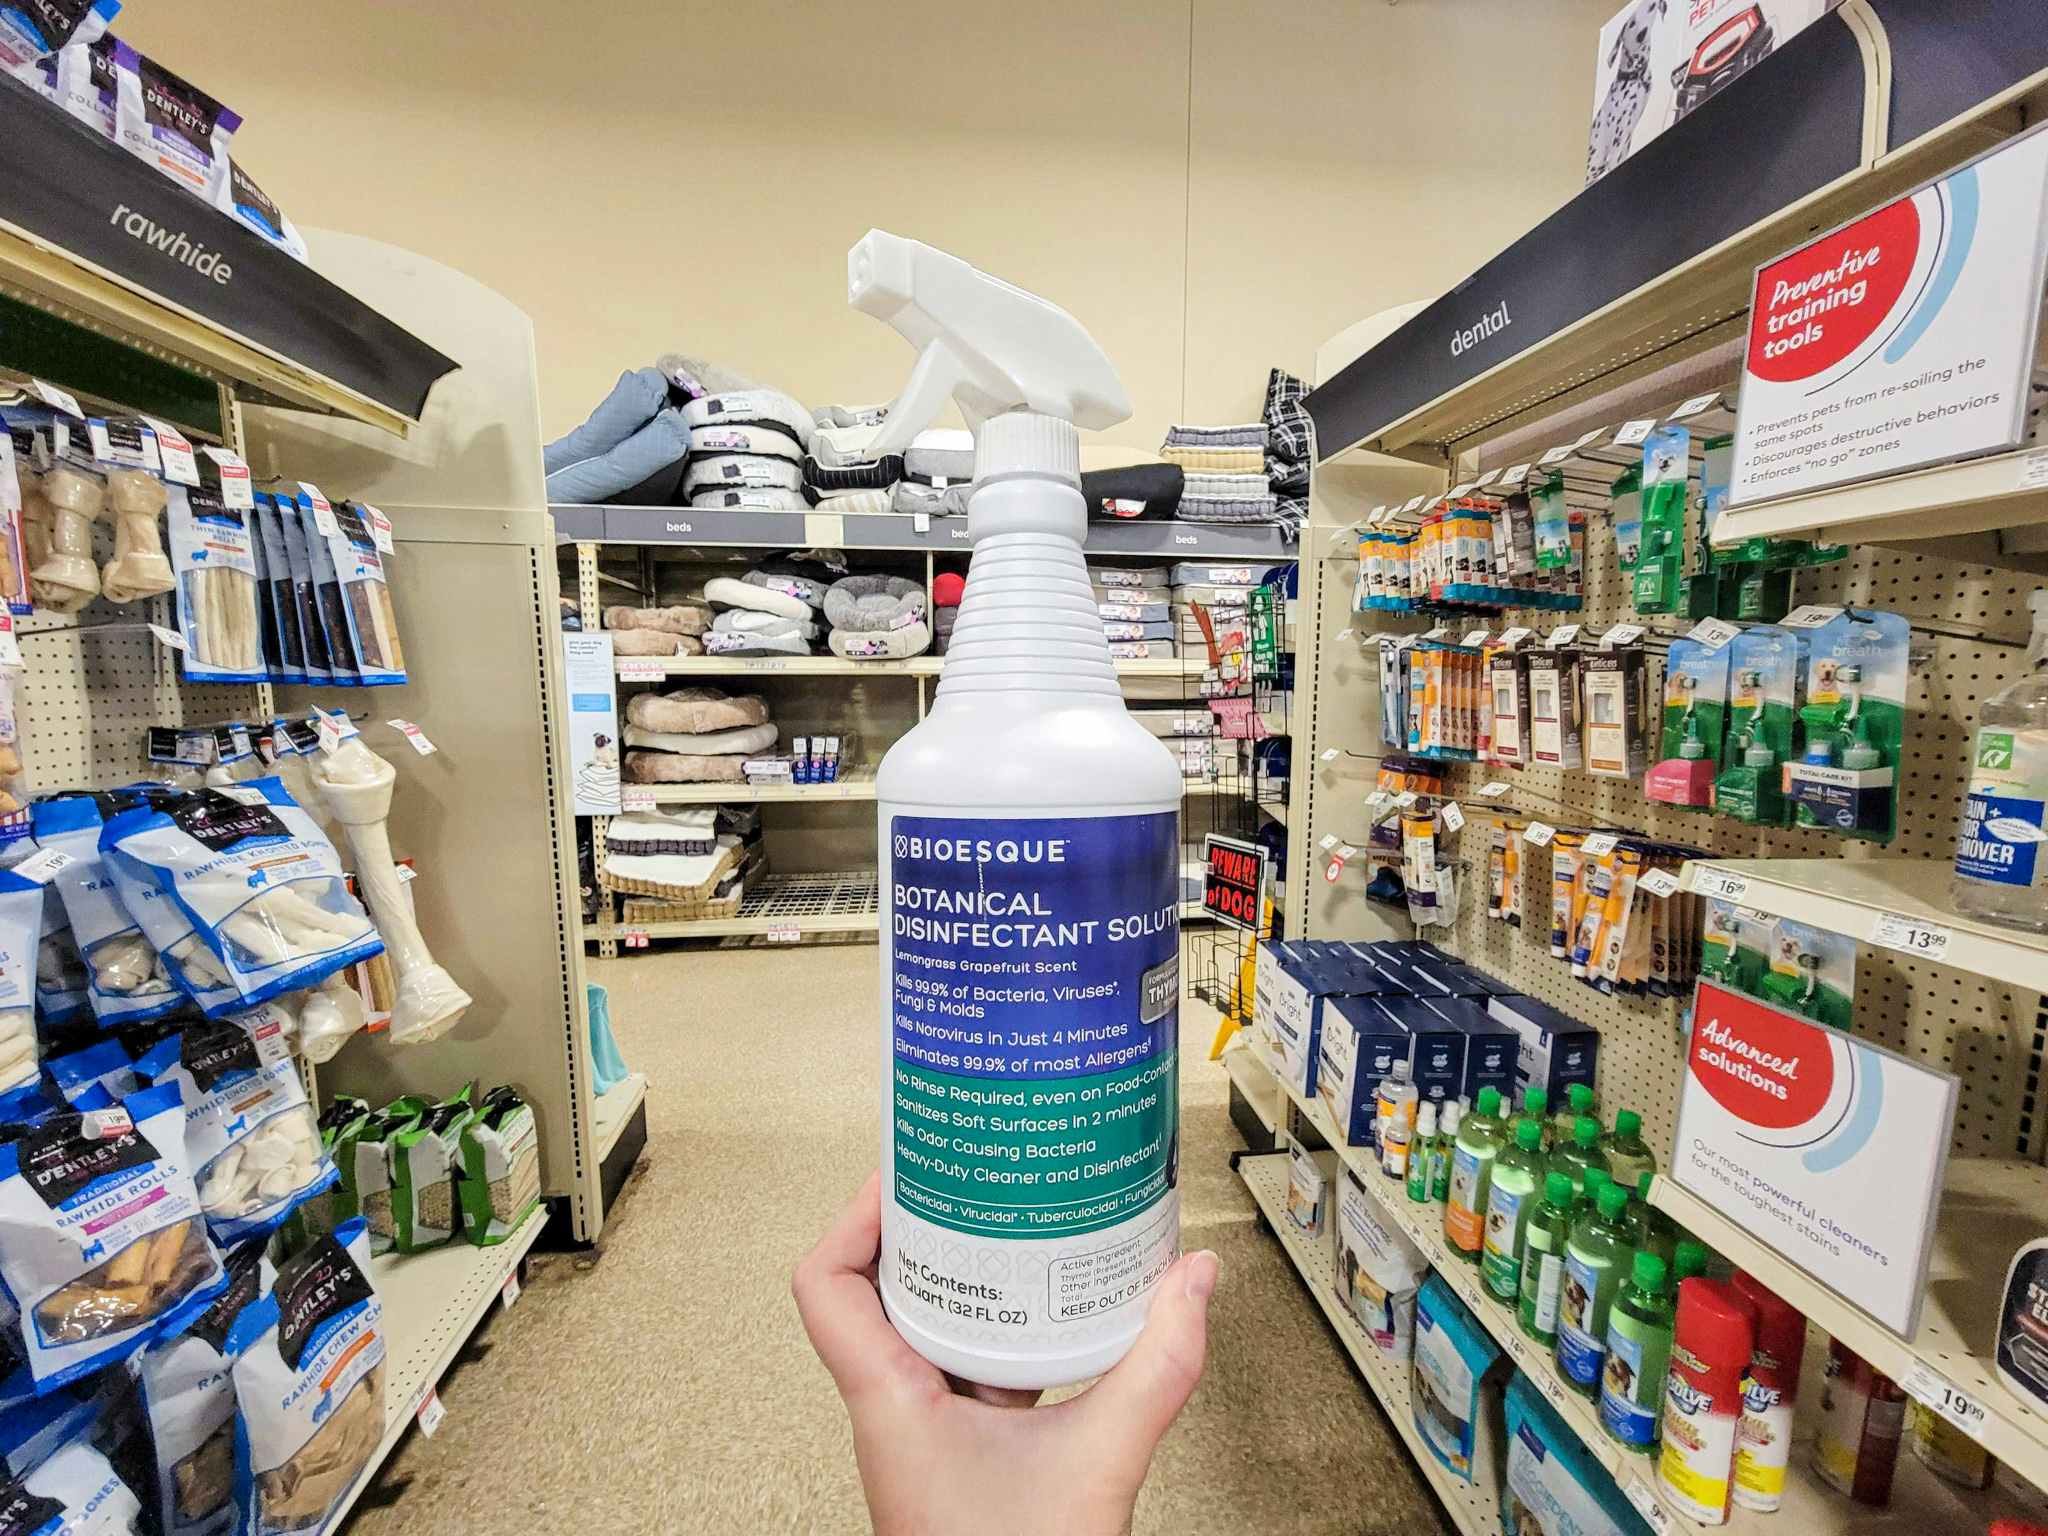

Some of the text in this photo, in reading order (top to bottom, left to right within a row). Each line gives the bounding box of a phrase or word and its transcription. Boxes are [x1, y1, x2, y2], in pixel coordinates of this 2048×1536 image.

[147, 88, 209, 135] DENTLEY'S
[110, 204, 234, 285] rawhide
[1769, 244, 1880, 311] Preventive
[1768, 279, 1868, 334] training
[1451, 301, 1511, 357] dental
[1765, 322, 1823, 358] tools
[1756, 356, 1986, 436] Prevents pets from re-soiling the
[1752, 391, 2000, 467] Discourages destructive behaviors
[1754, 421, 1823, 450] same spots
[1750, 462, 1801, 484] Enforces
[1859, 438, 1901, 457] zones
[667, 521, 692, 533] beds
[1176, 535, 1198, 545] beds
[193, 815, 273, 838] DENTLEY'S
[184, 854, 243, 880] RAWHIDE
[910, 838, 1066, 863] BIOESQUE
[1211, 847, 1257, 885] BEWARE
[895, 884, 1052, 916] BOTANICAL
[1208, 885, 1255, 921] of DOG
[895, 914, 1099, 947] DISINFECTANT
[895, 949, 1077, 974] Lemongrass Grapefruit Scent
[895, 971, 913, 990] Kills
[915, 979, 948, 998] 99.9%
[952, 986, 968, 999] of
[973, 985, 1049, 1004] Bacteria,
[895, 989, 985, 1018] Fungi & Molds
[895, 1013, 913, 1032] Kills
[915, 1020, 983, 1044] Norovirus
[1008, 1031, 1048, 1046] Just
[1052, 1031, 1063, 1045] 4
[1067, 1023, 1128, 1044] Minutes
[1701, 1018, 1800, 1081] Advanced
[896, 1038, 959, 1068] Eliminates
[963, 1055, 1006, 1073] 99.9%
[1011, 1058, 1029, 1073] of
[1034, 1055, 1081, 1072] most
[1699, 1047, 1789, 1101] solutions
[896, 1068, 909, 1085] No
[911, 1074, 946, 1097] Rinse
[950, 1086, 1028, 1108] Required,
[1032, 1090, 1076, 1106] even
[1080, 1087, 1101, 1102] on
[896, 1092, 949, 1123] Sanitizes
[952, 1112, 986, 1130] Soft
[990, 1115, 1068, 1133] Surfaces
[1092, 1113, 1101, 1126] 2
[1106, 1093, 1157, 1122] minutes
[896, 1116, 1097, 1161] Kills Odor Causing Bacteria
[37, 1135, 137, 1186] DENTLEY'S
[896, 1141, 970, 1181] Heavy-Duty
[974, 1167, 1041, 1185] Cleaner
[1046, 1167, 1079, 1184] and
[56, 1165, 178, 1229] RAWHIDE ROLLS
[72, 1167, 141, 1206] TRADITIONAL
[899, 1180, 953, 1213] Bactericidal
[1027, 1199, 1118, 1225] Tuberculocidal
[1691, 1152, 1841, 1258] for the toughest stains
[1692, 1138, 1889, 1267] Our most powerful cleaners
[898, 1247, 1004, 1302] Net Contents:
[1061, 1258, 1093, 1272] Active
[1061, 1260, 1143, 1294] Other Ingredients
[904, 1276, 945, 1311] Quart
[948, 1299, 973, 1319] (32
[976, 1307, 995, 1323] FL
[998, 1308, 1028, 1326] OZ)
[1061, 1300, 1096, 1317] KEEP
[1099, 1291, 1124, 1309] OUT
[1127, 1280, 1141, 1297] OF
[1143, 1259, 1168, 1286] REACH
[282, 1354, 330, 1411] RAWHIDE
[328, 1322, 361, 1356] CHEW
